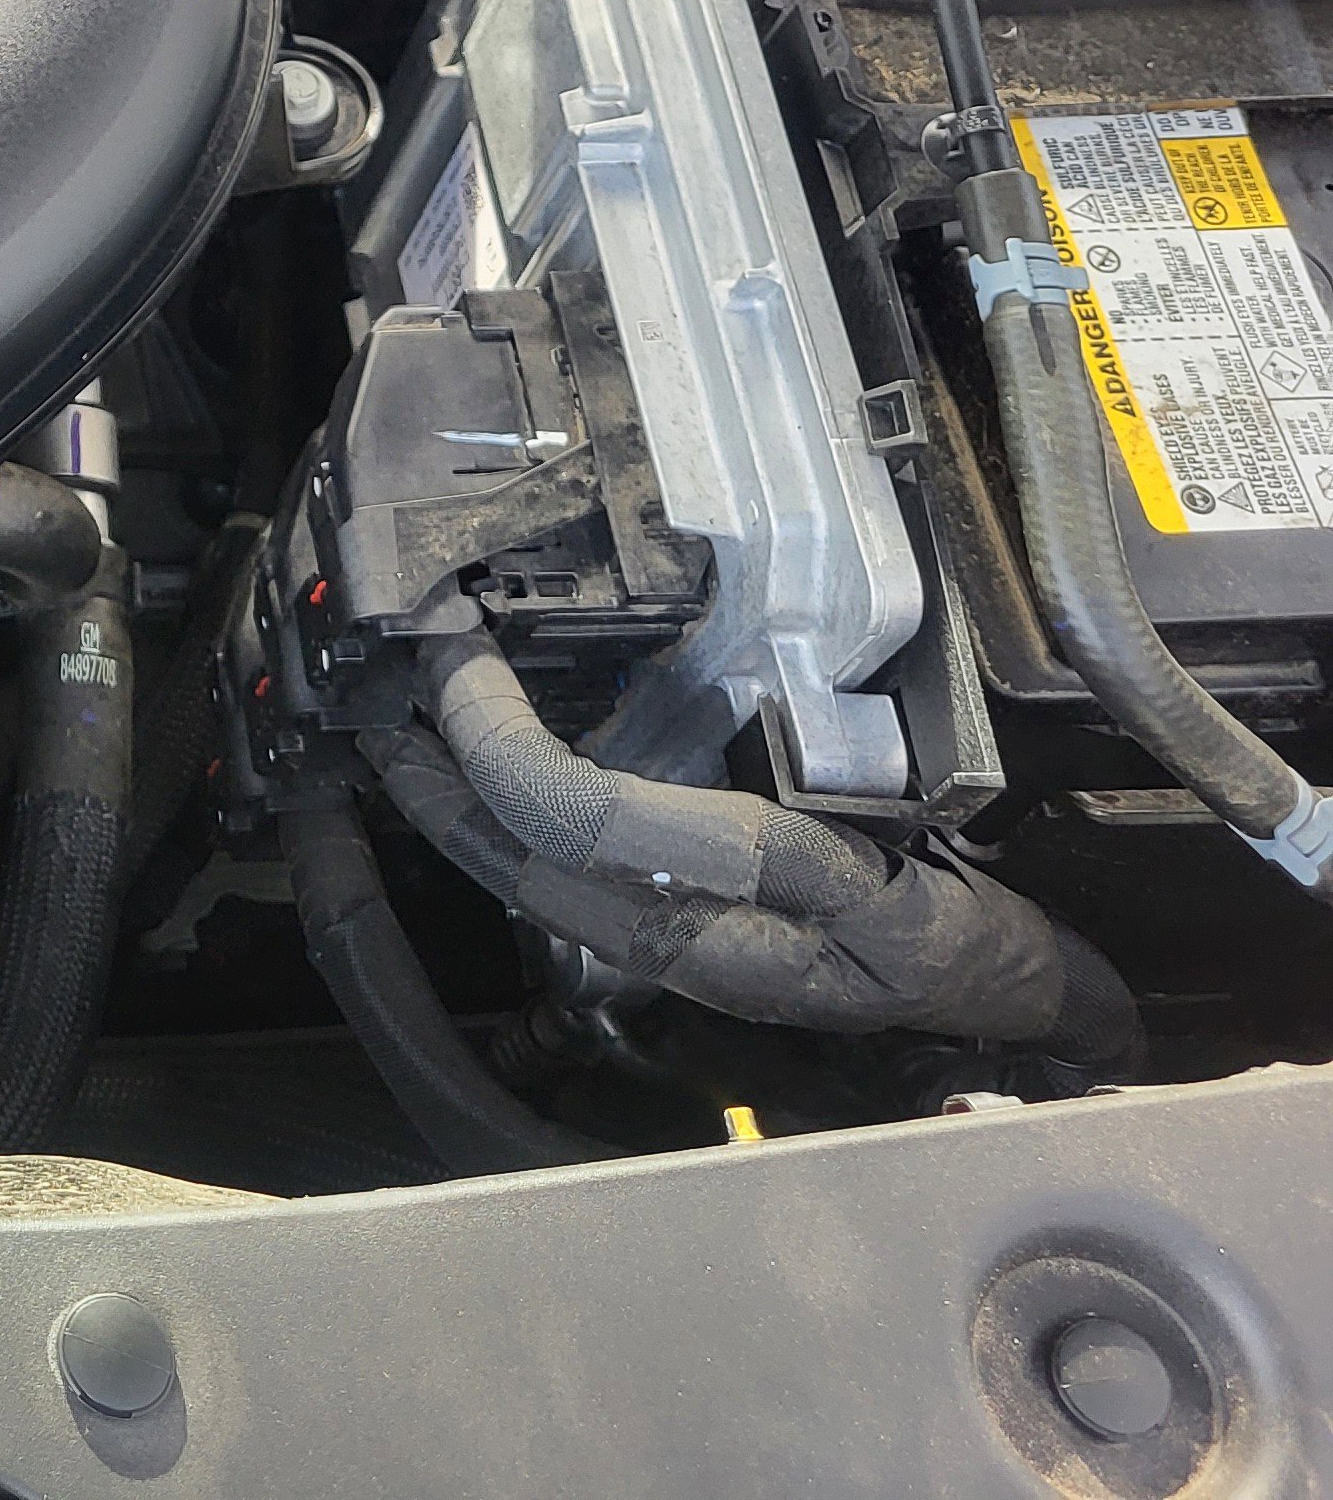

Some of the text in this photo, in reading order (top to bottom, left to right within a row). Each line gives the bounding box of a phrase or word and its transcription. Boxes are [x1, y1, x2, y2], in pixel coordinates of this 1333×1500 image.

[1160, 117, 1175, 132] DO
[1197, 116, 1214, 129] NE
[1043, 138, 1074, 189] SULFURIC
[1062, 141, 1090, 189] ACID CAN
[1098, 122, 1136, 182] SULFURIQUE
[1131, 141, 1144, 155] LA
[1217, 153, 1232, 165] LA
[1075, 136, 1120, 223] CAUSE BLINDNESS
[1106, 171, 1130, 206] SEVERE
[1134, 156, 1159, 194] CAUSER
[1151, 199, 1171, 222] PEUT
[1160, 186, 1175, 208] DES
[1172, 209, 1184, 221] OU
[1119, 209, 1136, 223] OR
[1135, 272, 1162, 315] SMOKING
[1173, 246, 1210, 314] LES FLAMMES
[1194, 264, 1224, 313] DE FUMER
[1207, 241, 1261, 348] FLUSH EYES IMMEDIATELY
[1251, 268, 1268, 290] HELP
[1112, 280, 1135, 316] SPARKS
[1125, 279, 1149, 316] FLAMES
[1156, 283, 1184, 322] ÉVITER
[1179, 297, 1197, 314] LES
[1264, 293, 1285, 329] MEDICAL
[1108, 310, 1126, 324] NO
[1074, 290, 1127, 393] DANGER
[1259, 327, 1278, 348] WITH
[1276, 332, 1294, 347] GET
[1292, 326, 1309, 346] YEUX
[1302, 347, 1318, 361] LES
[1312, 333, 1327, 345] UN
[1307, 363, 1329, 391] RINCEZ
[1200, 400, 1214, 415] OR
[1249, 399, 1279, 443] RENDRE
[1168, 414, 1209, 480] EXPLOSIVE
[1213, 346, 1294, 514] LES GAZ EXPLOSIFS PEUVENT
[1286, 418, 1309, 454] BATTERY
[1304, 432, 1321, 454] MUST
[1165, 440, 1193, 480] SHIELD
[1189, 419, 1225, 479] CAN CAUSE
[1207, 418, 1241, 479] BLINDNESS
[1213, 388, 1276, 514] PROTÉGEZ LES YEUX.
[1271, 445, 1286, 461] OU
[1278, 463, 1309, 513] BLESSER
[80, 621, 100, 652] GM
[60, 652, 118, 688] 84897708
